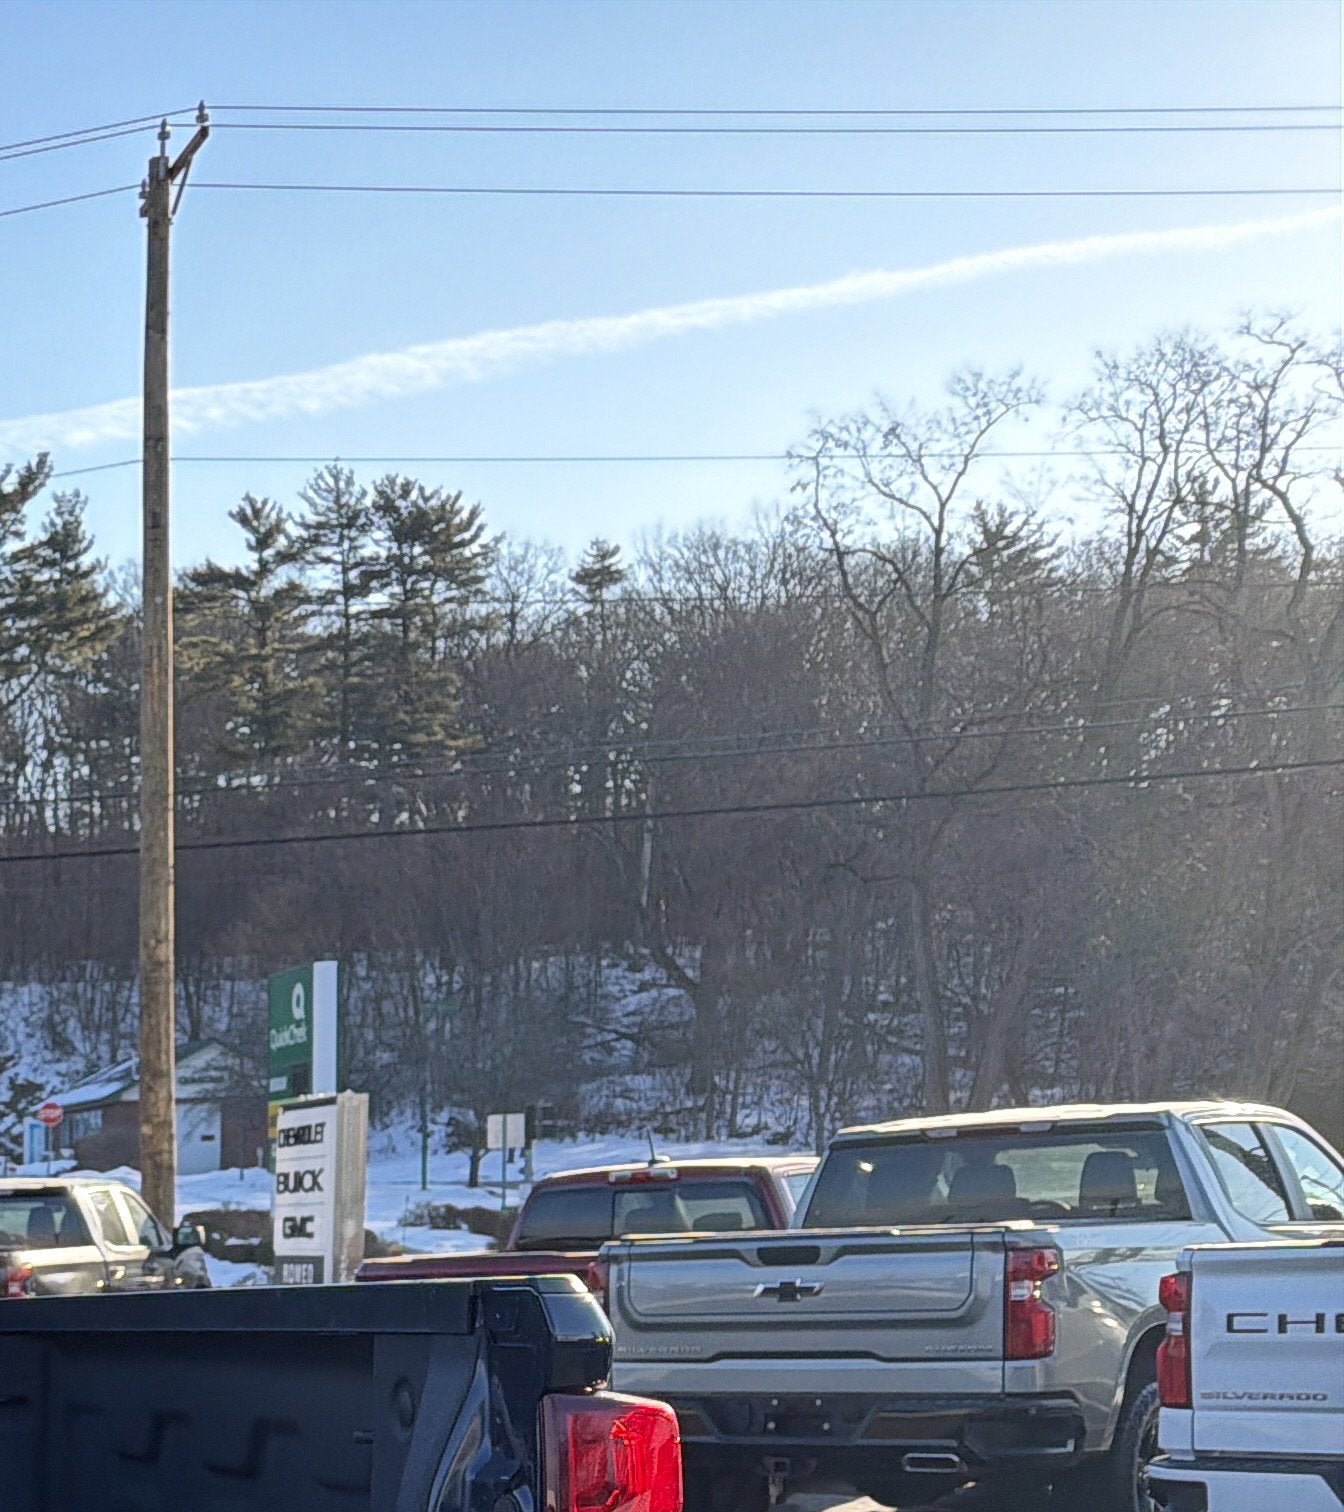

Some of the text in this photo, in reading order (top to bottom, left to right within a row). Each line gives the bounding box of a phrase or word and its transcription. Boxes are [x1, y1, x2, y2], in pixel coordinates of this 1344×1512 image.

[279, 1122, 326, 1148] CHEVROLET
[277, 1168, 324, 1194] BUICK
[282, 1215, 314, 1239] GMC
[1227, 1313, 1344, 1334] CH
[1200, 1392, 1329, 1402] SILVERADO
